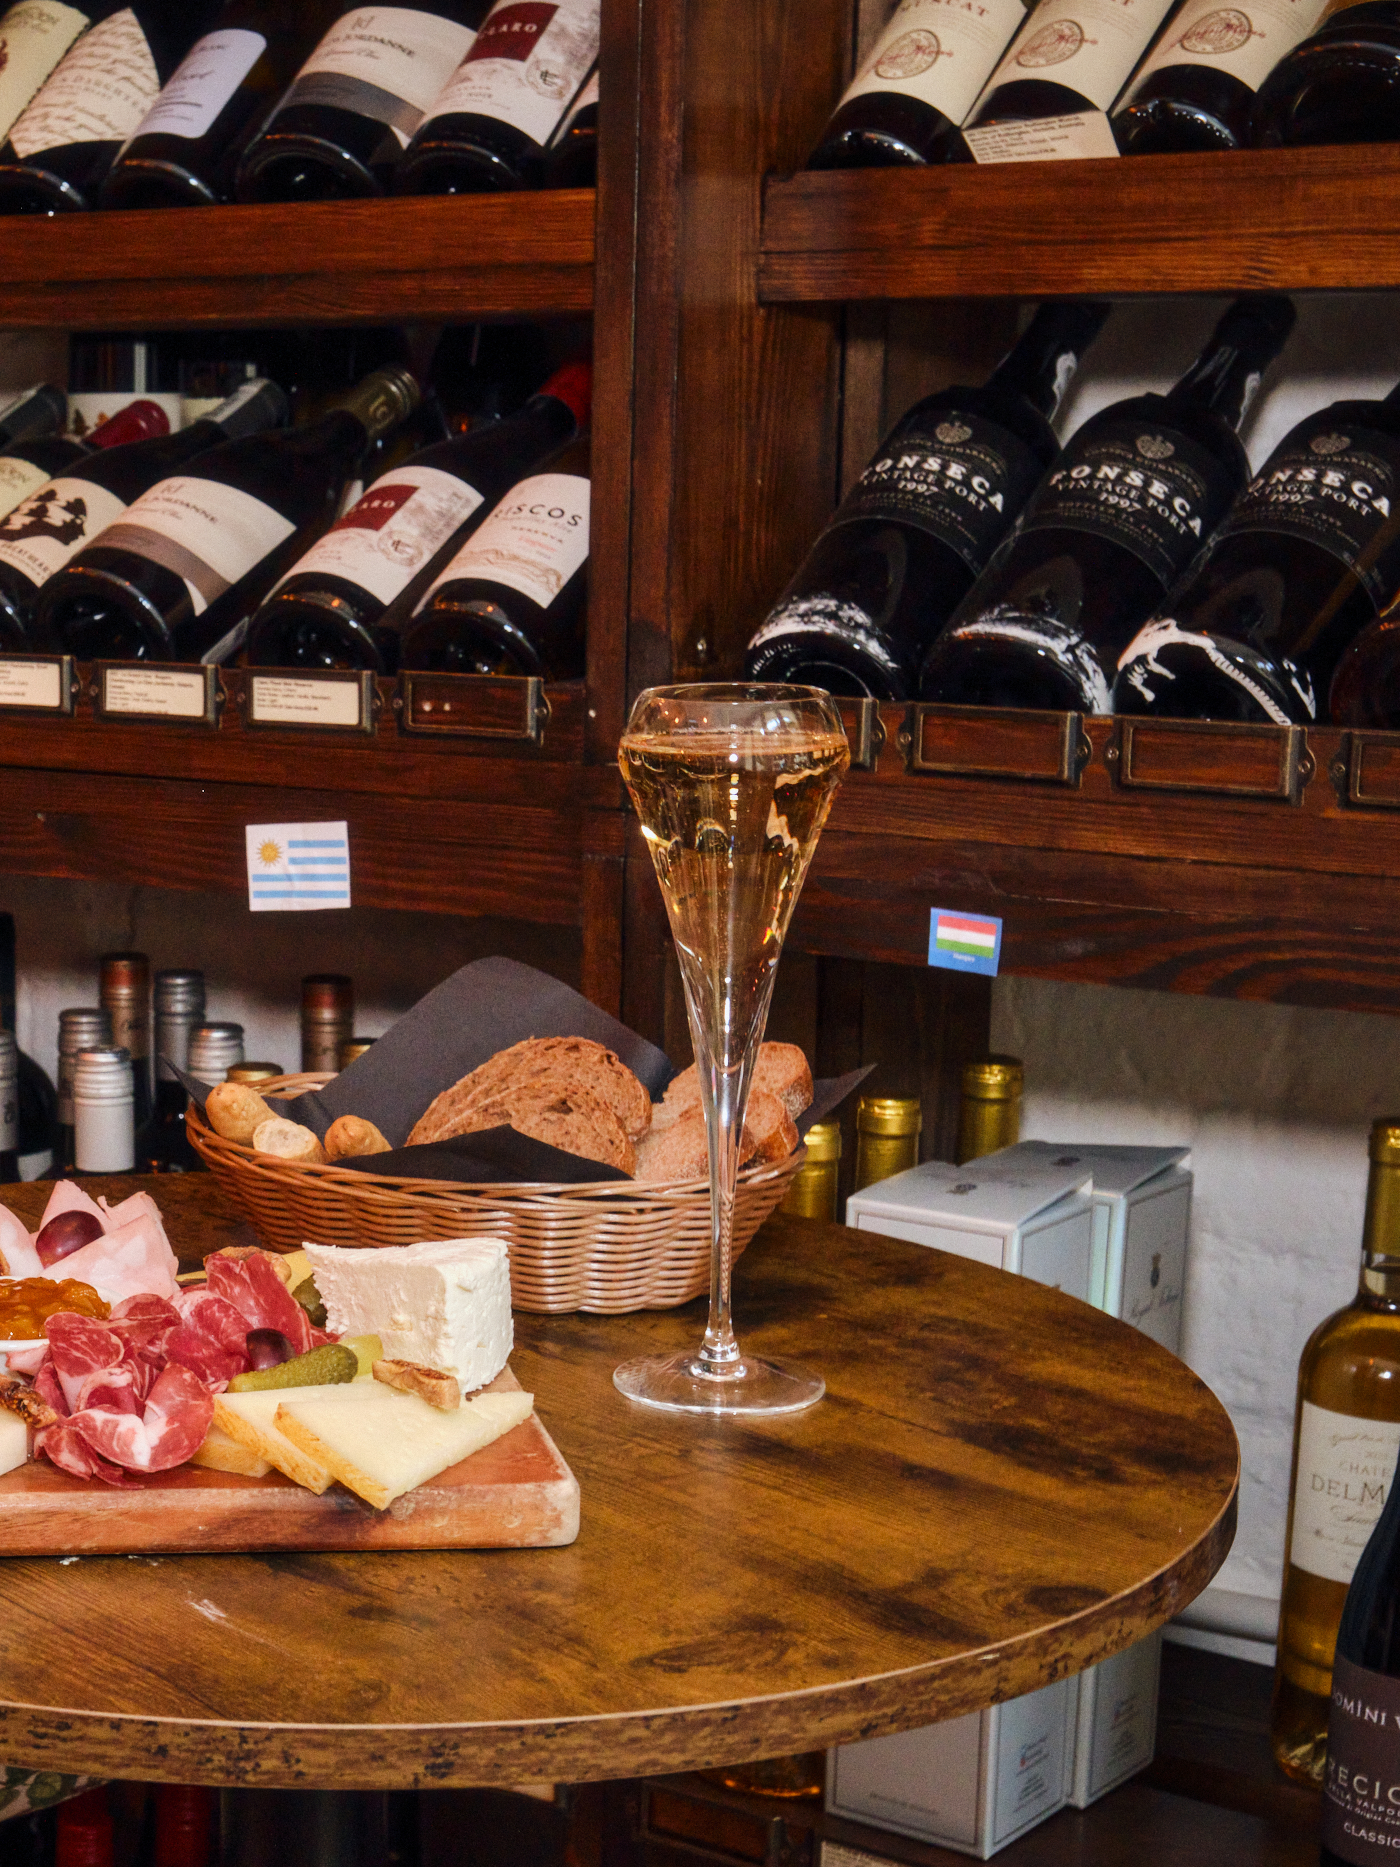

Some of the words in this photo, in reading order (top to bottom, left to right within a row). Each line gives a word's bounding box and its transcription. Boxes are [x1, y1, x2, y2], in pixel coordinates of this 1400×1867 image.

[898, 479, 940, 496] 1997
[944, 478, 988, 512] PORT
[1050, 465, 1202, 538] FONSECA
[1099, 491, 1144, 513] 1997
[1248, 467, 1391, 519] ONSECA
[1320, 486, 1373, 517] PORT
[1057, 479, 1141, 501] VINTAGE
[1147, 497, 1188, 535] PORT
[1339, 1461, 1389, 1478] CHATE
[1311, 1474, 1386, 1505] DELM
[1356, 1798, 1400, 1818] VALPO
[1343, 1821, 1400, 1849] CLASSIC
